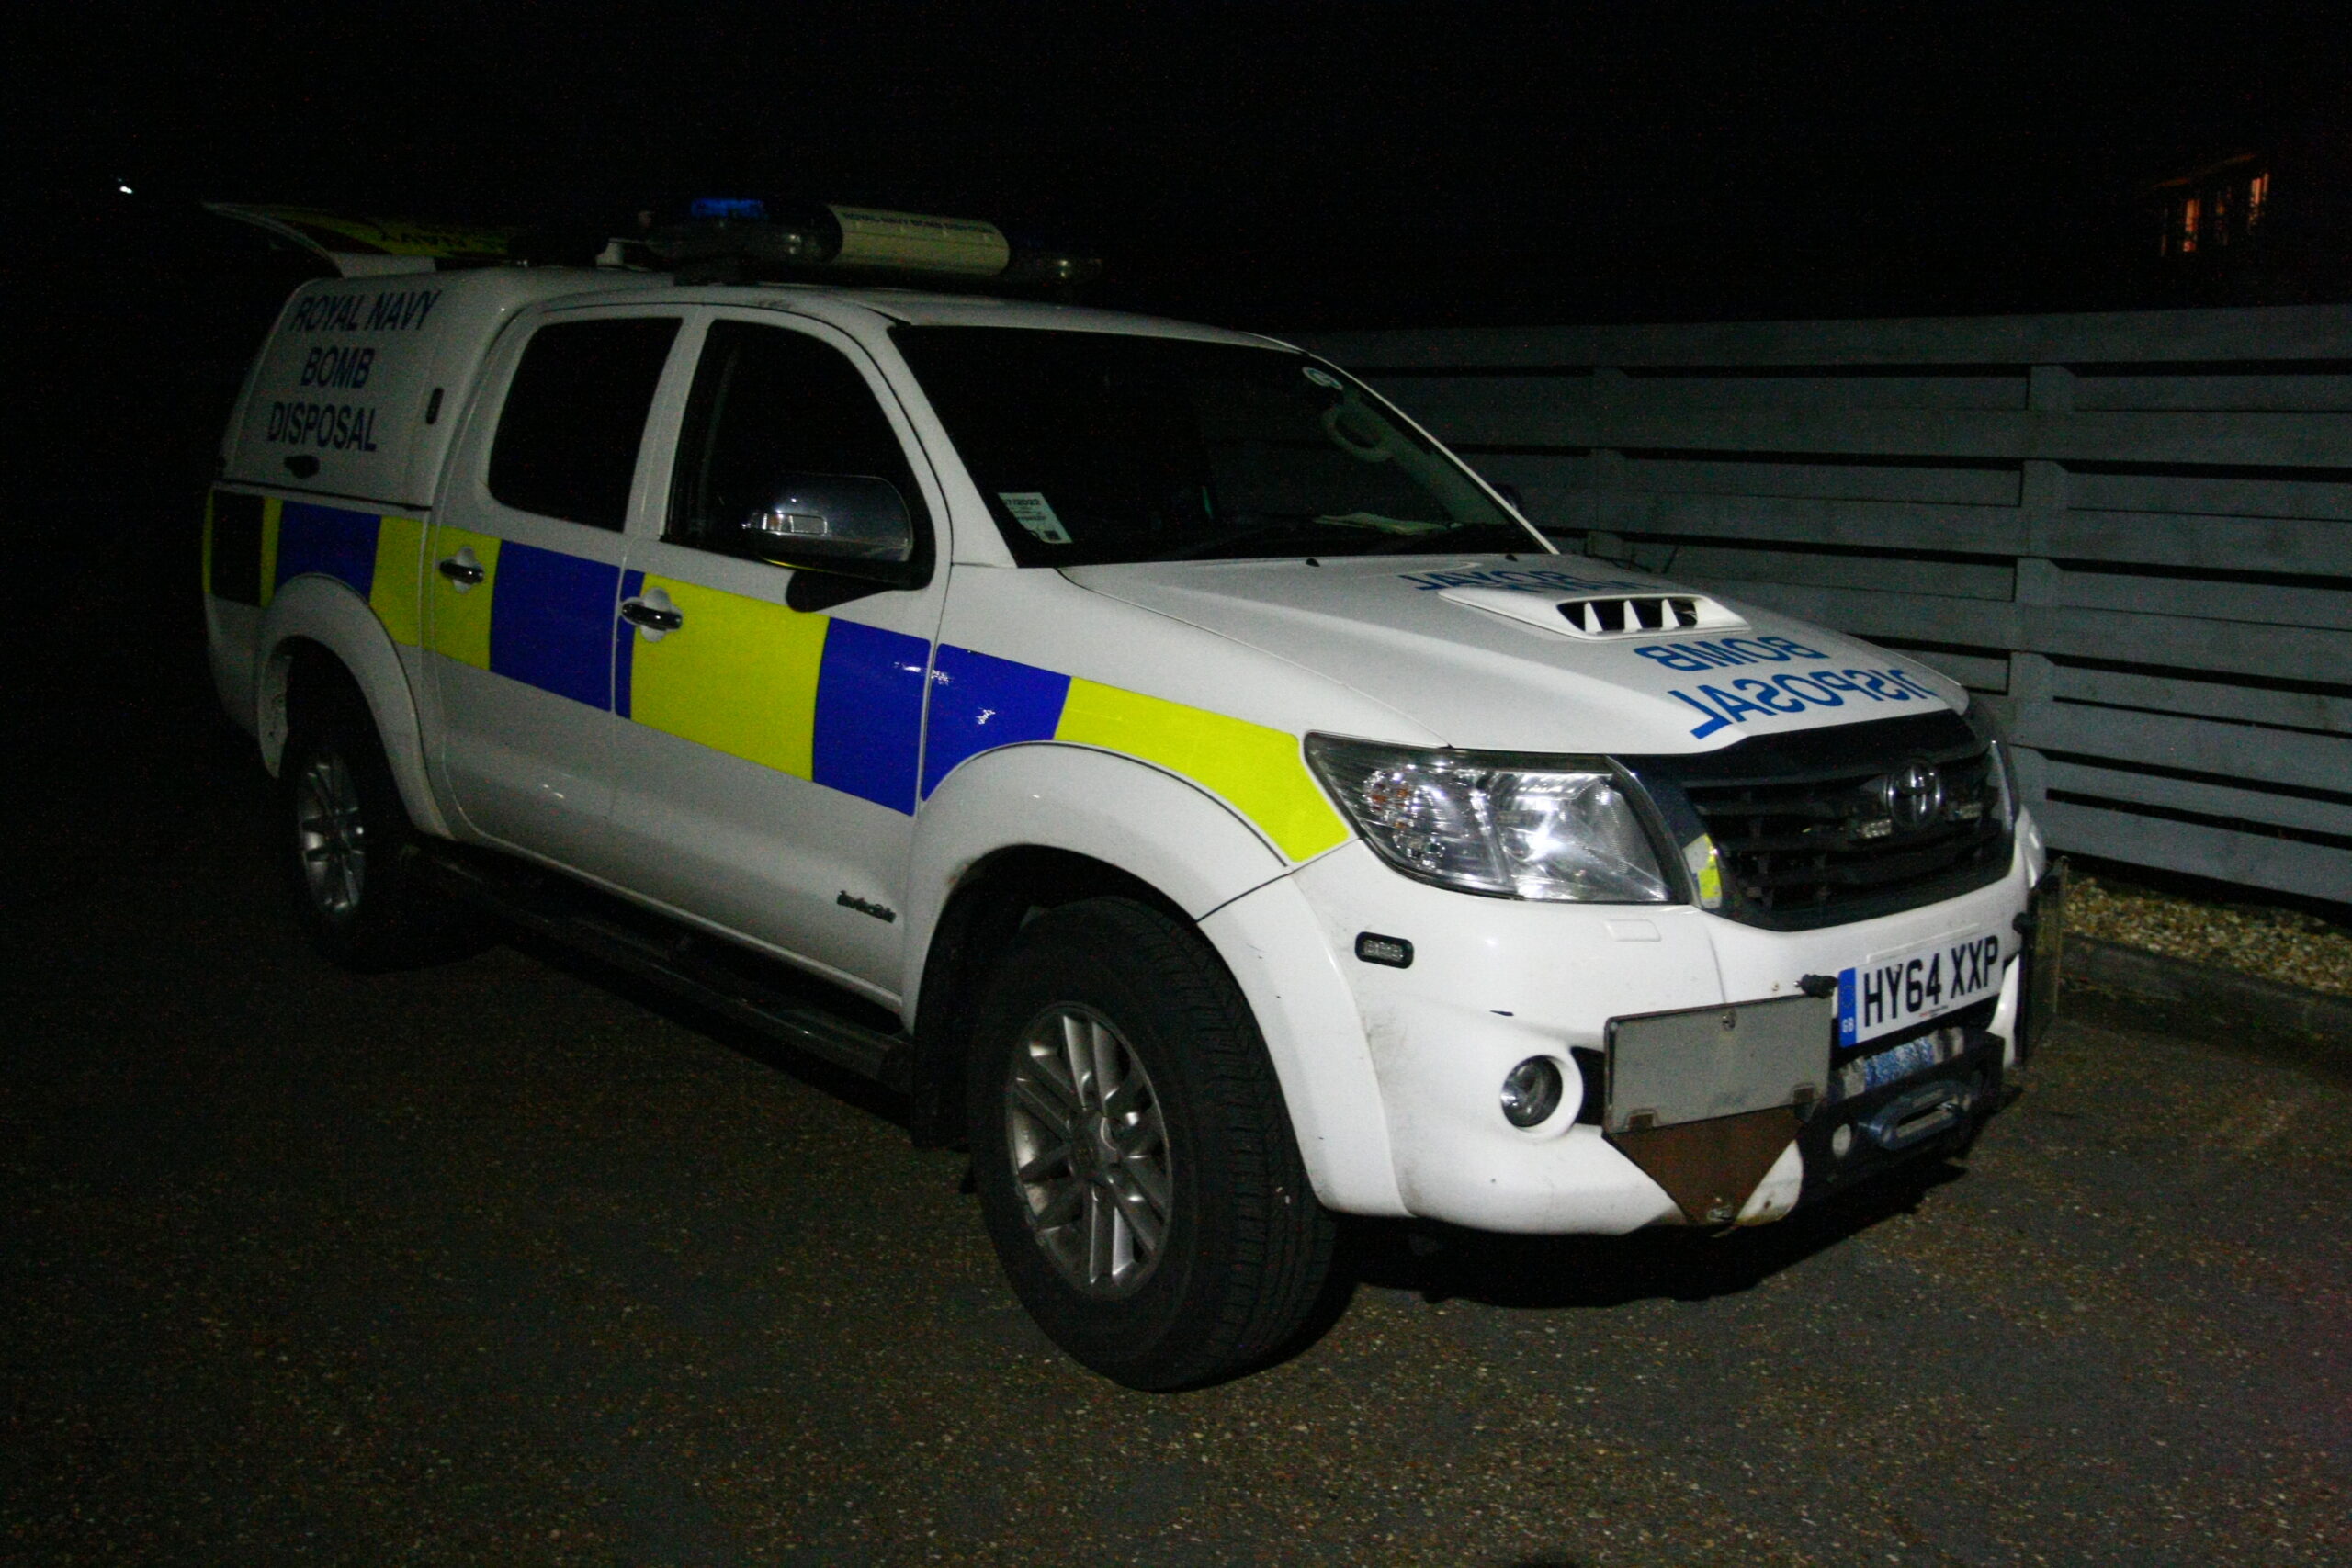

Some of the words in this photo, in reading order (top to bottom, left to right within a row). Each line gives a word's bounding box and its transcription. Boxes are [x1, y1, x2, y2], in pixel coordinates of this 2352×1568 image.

[289, 295, 366, 331] ROYAL
[365, 289, 442, 331] NAVY
[300, 345, 375, 388] BOMB
[265, 401, 377, 452] DISPOSAL
[1864, 953, 1941, 1028] HY64
[1951, 935, 1999, 999] XXP
[1842, 1017, 1854, 1032] GB
